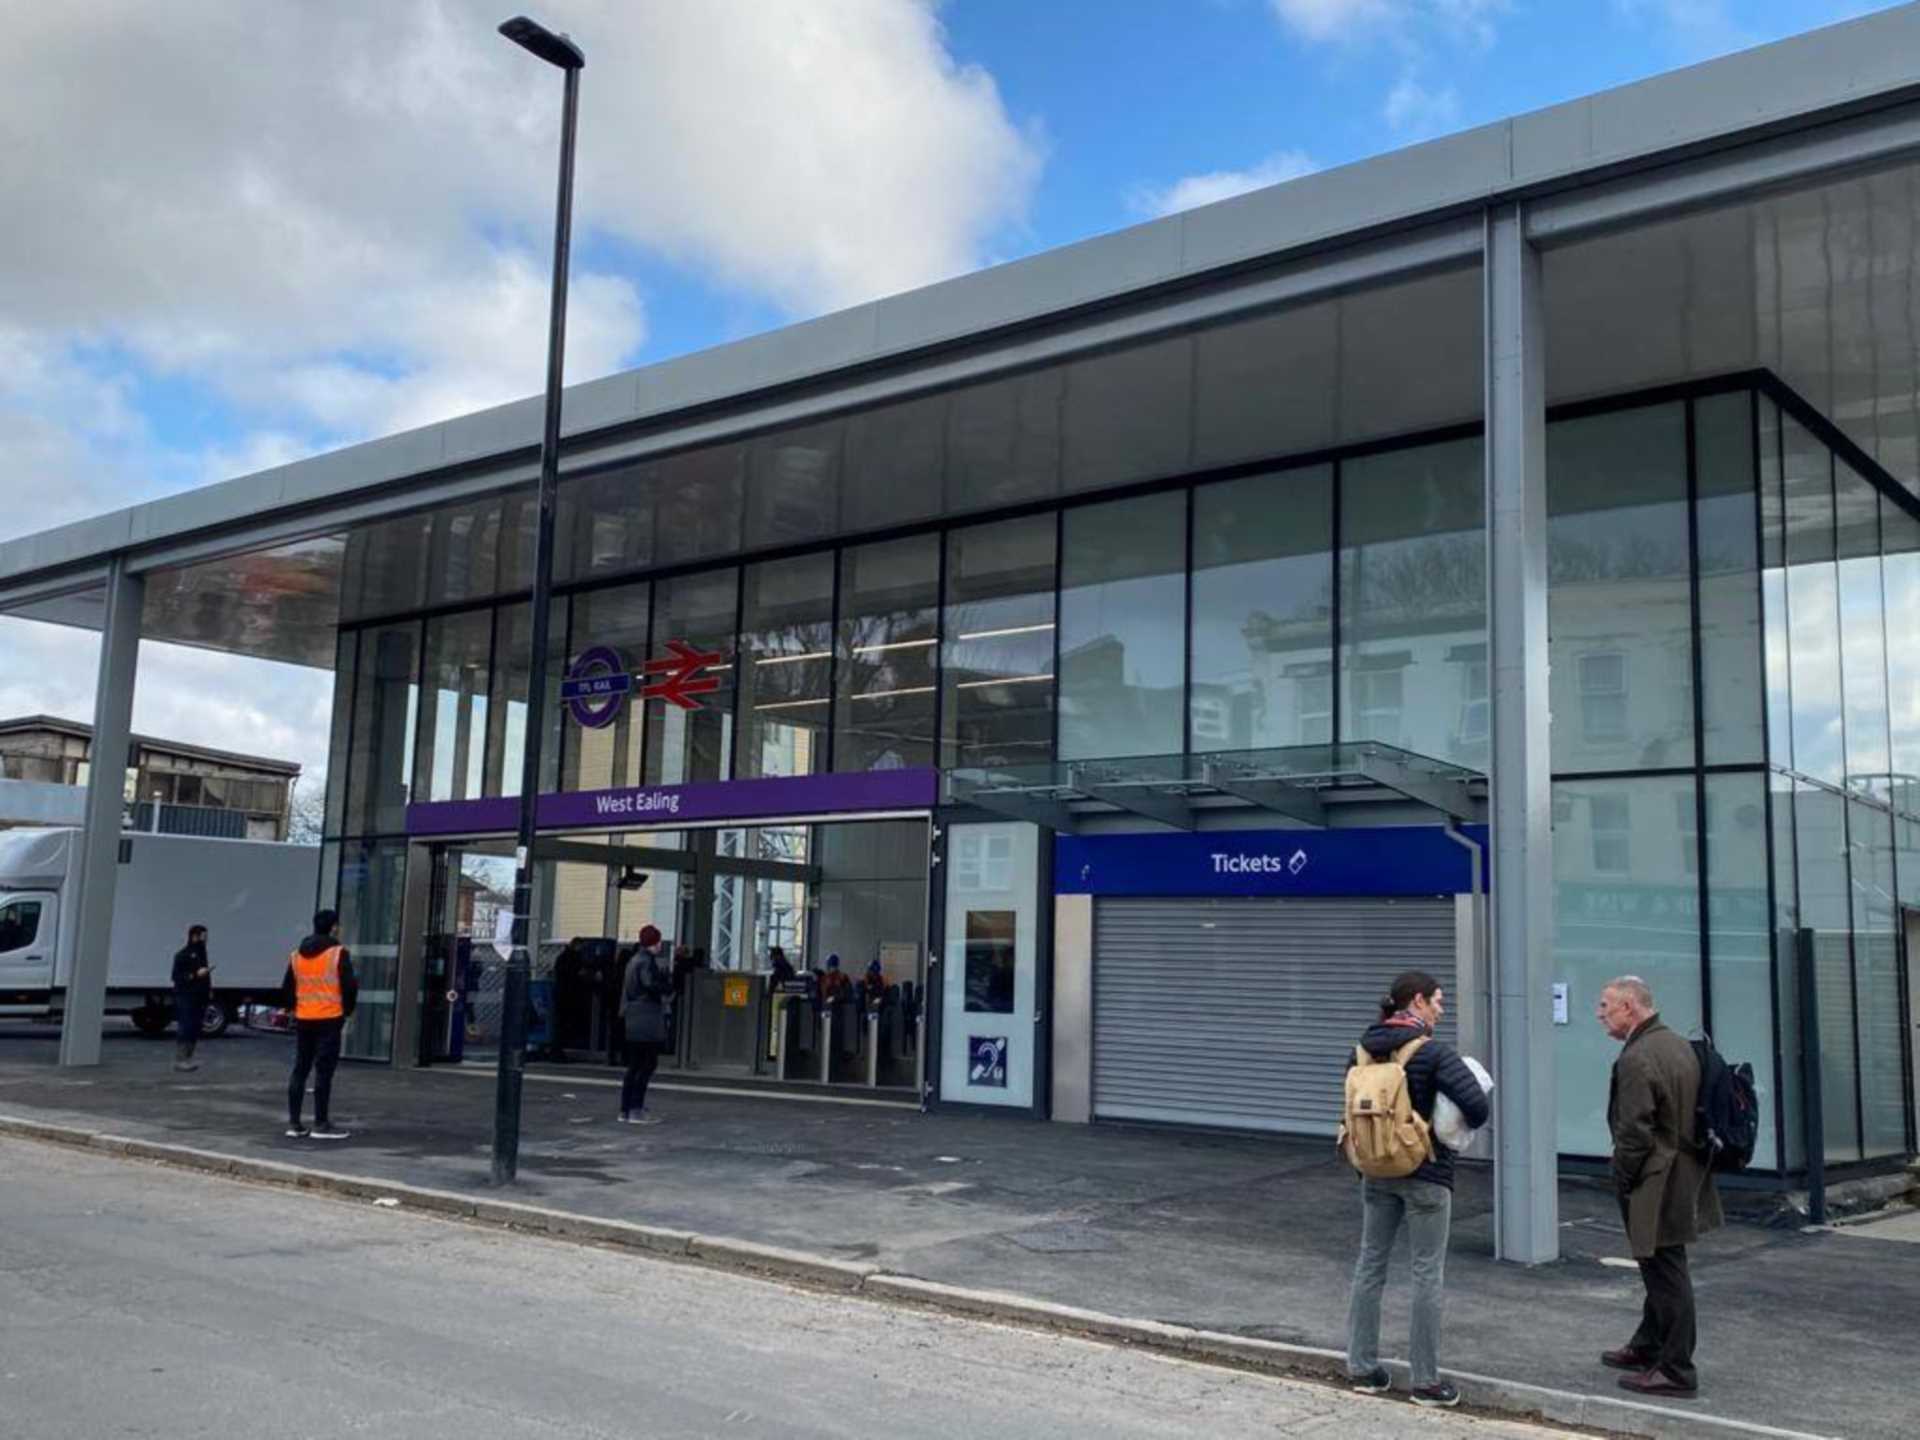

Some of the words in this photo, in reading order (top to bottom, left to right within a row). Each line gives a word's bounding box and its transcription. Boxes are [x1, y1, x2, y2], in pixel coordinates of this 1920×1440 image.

[596, 795, 633, 814] West
[636, 792, 680, 813] Ealing
[1211, 853, 1281, 873] Tickets
